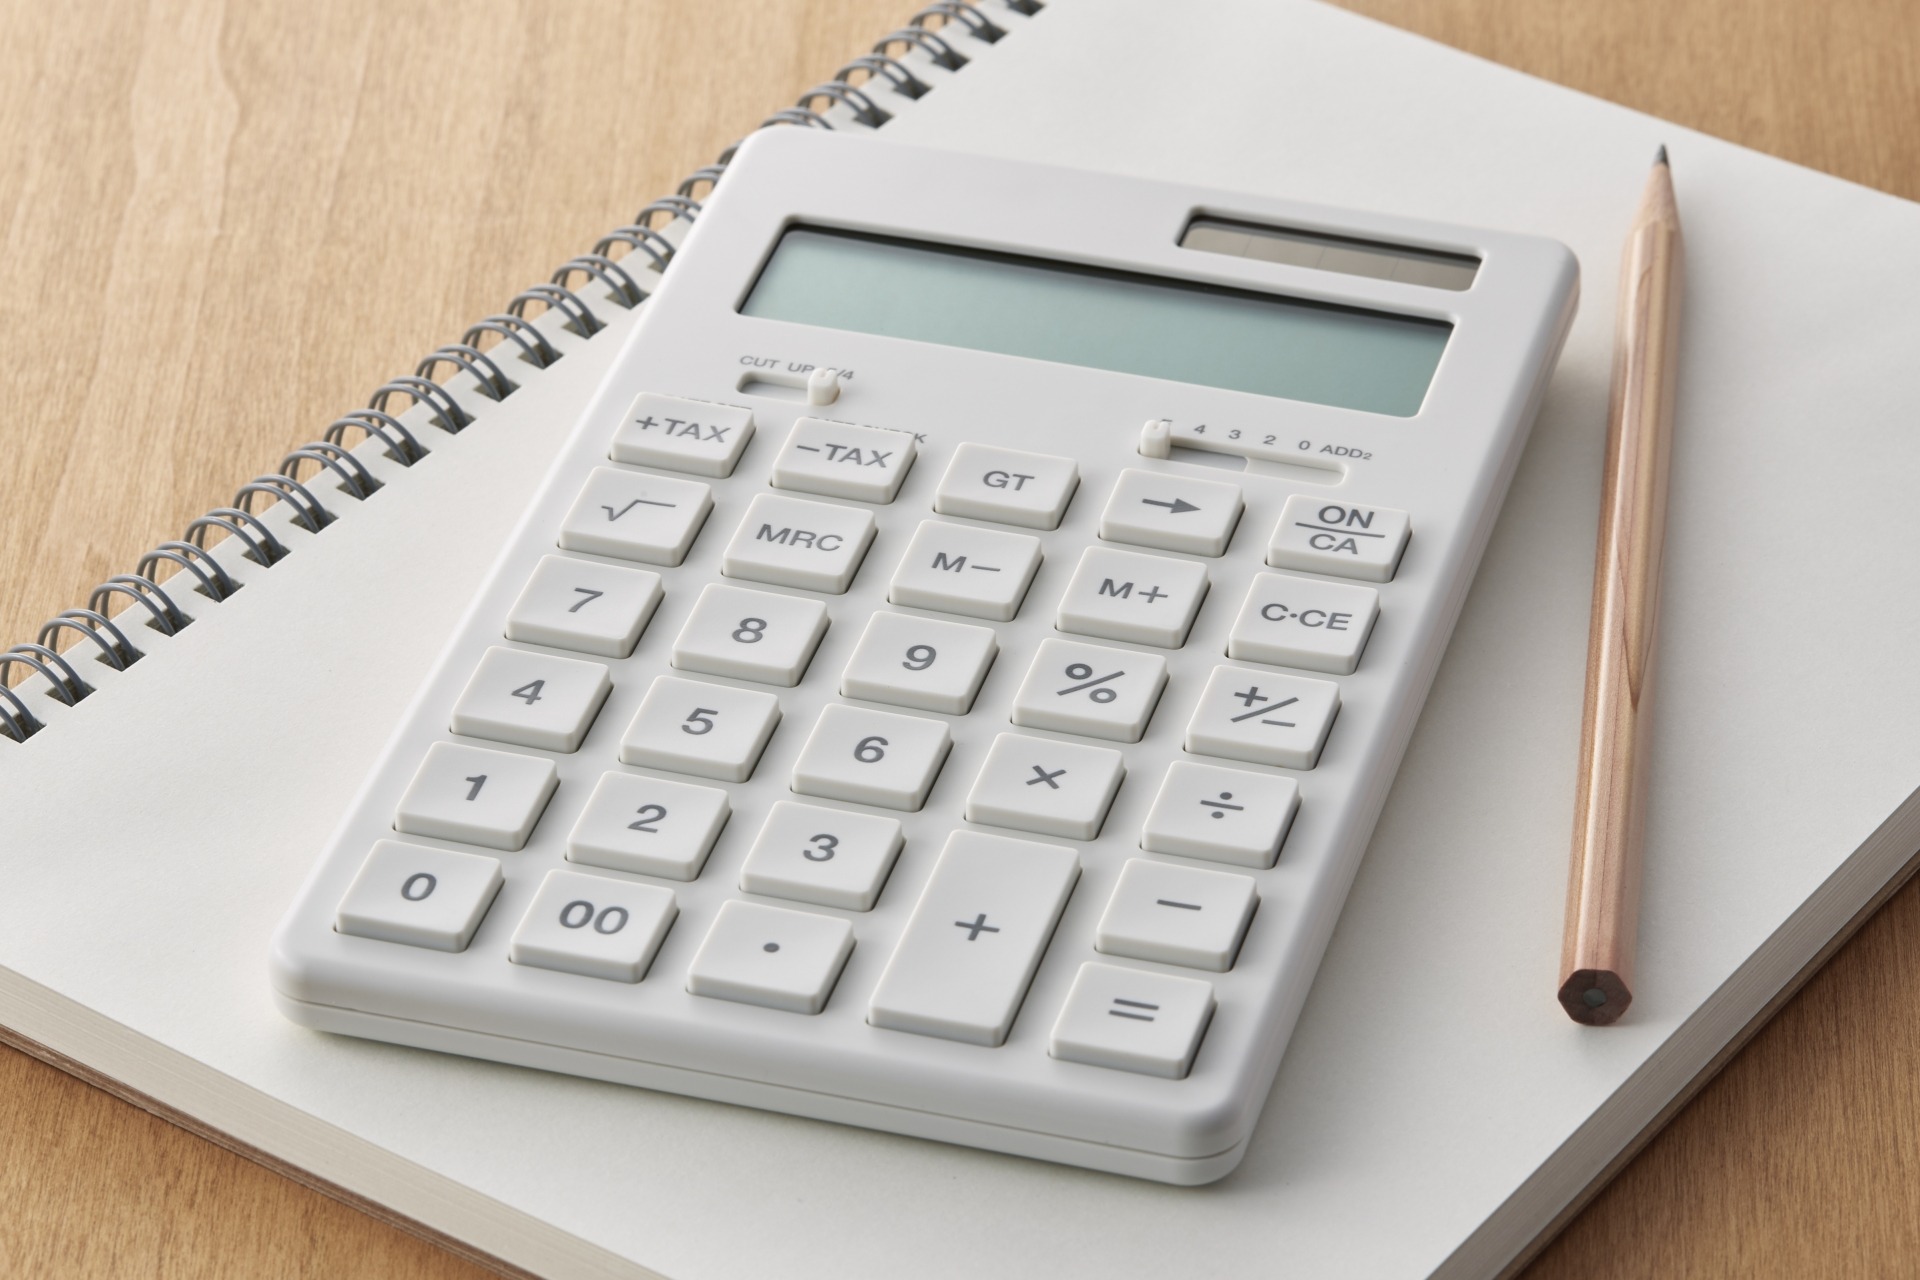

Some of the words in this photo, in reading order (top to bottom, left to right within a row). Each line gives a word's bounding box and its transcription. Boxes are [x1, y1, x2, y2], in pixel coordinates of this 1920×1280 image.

[739, 355, 781, 369] CUT
[788, 362, 816, 374] UP
[1193, 424, 1207, 435] 4
[1227, 429, 1241, 440] 3
[1262, 434, 1277, 446] 2
[982, 470, 1035, 491] GT
[1317, 505, 1375, 529] ON
[755, 523, 844, 552] MRC
[1308, 533, 1360, 555] CA
[570, 587, 604, 613] 7
[1098, 577, 1169, 604] M+
[732, 617, 768, 644] 8
[903, 644, 937, 671] 9
[510, 679, 546, 706] 4
[1056, 662, 1125, 704] %
[682, 707, 719, 736] 5
[853, 735, 889, 764] 6
[465, 774, 488, 802] 1
[627, 803, 668, 834] 2
[803, 833, 839, 862] 3
[401, 872, 438, 902] 0
[558, 899, 629, 935] 00
[954, 913, 1001, 942] +
[1108, 998, 1160, 1023] =
